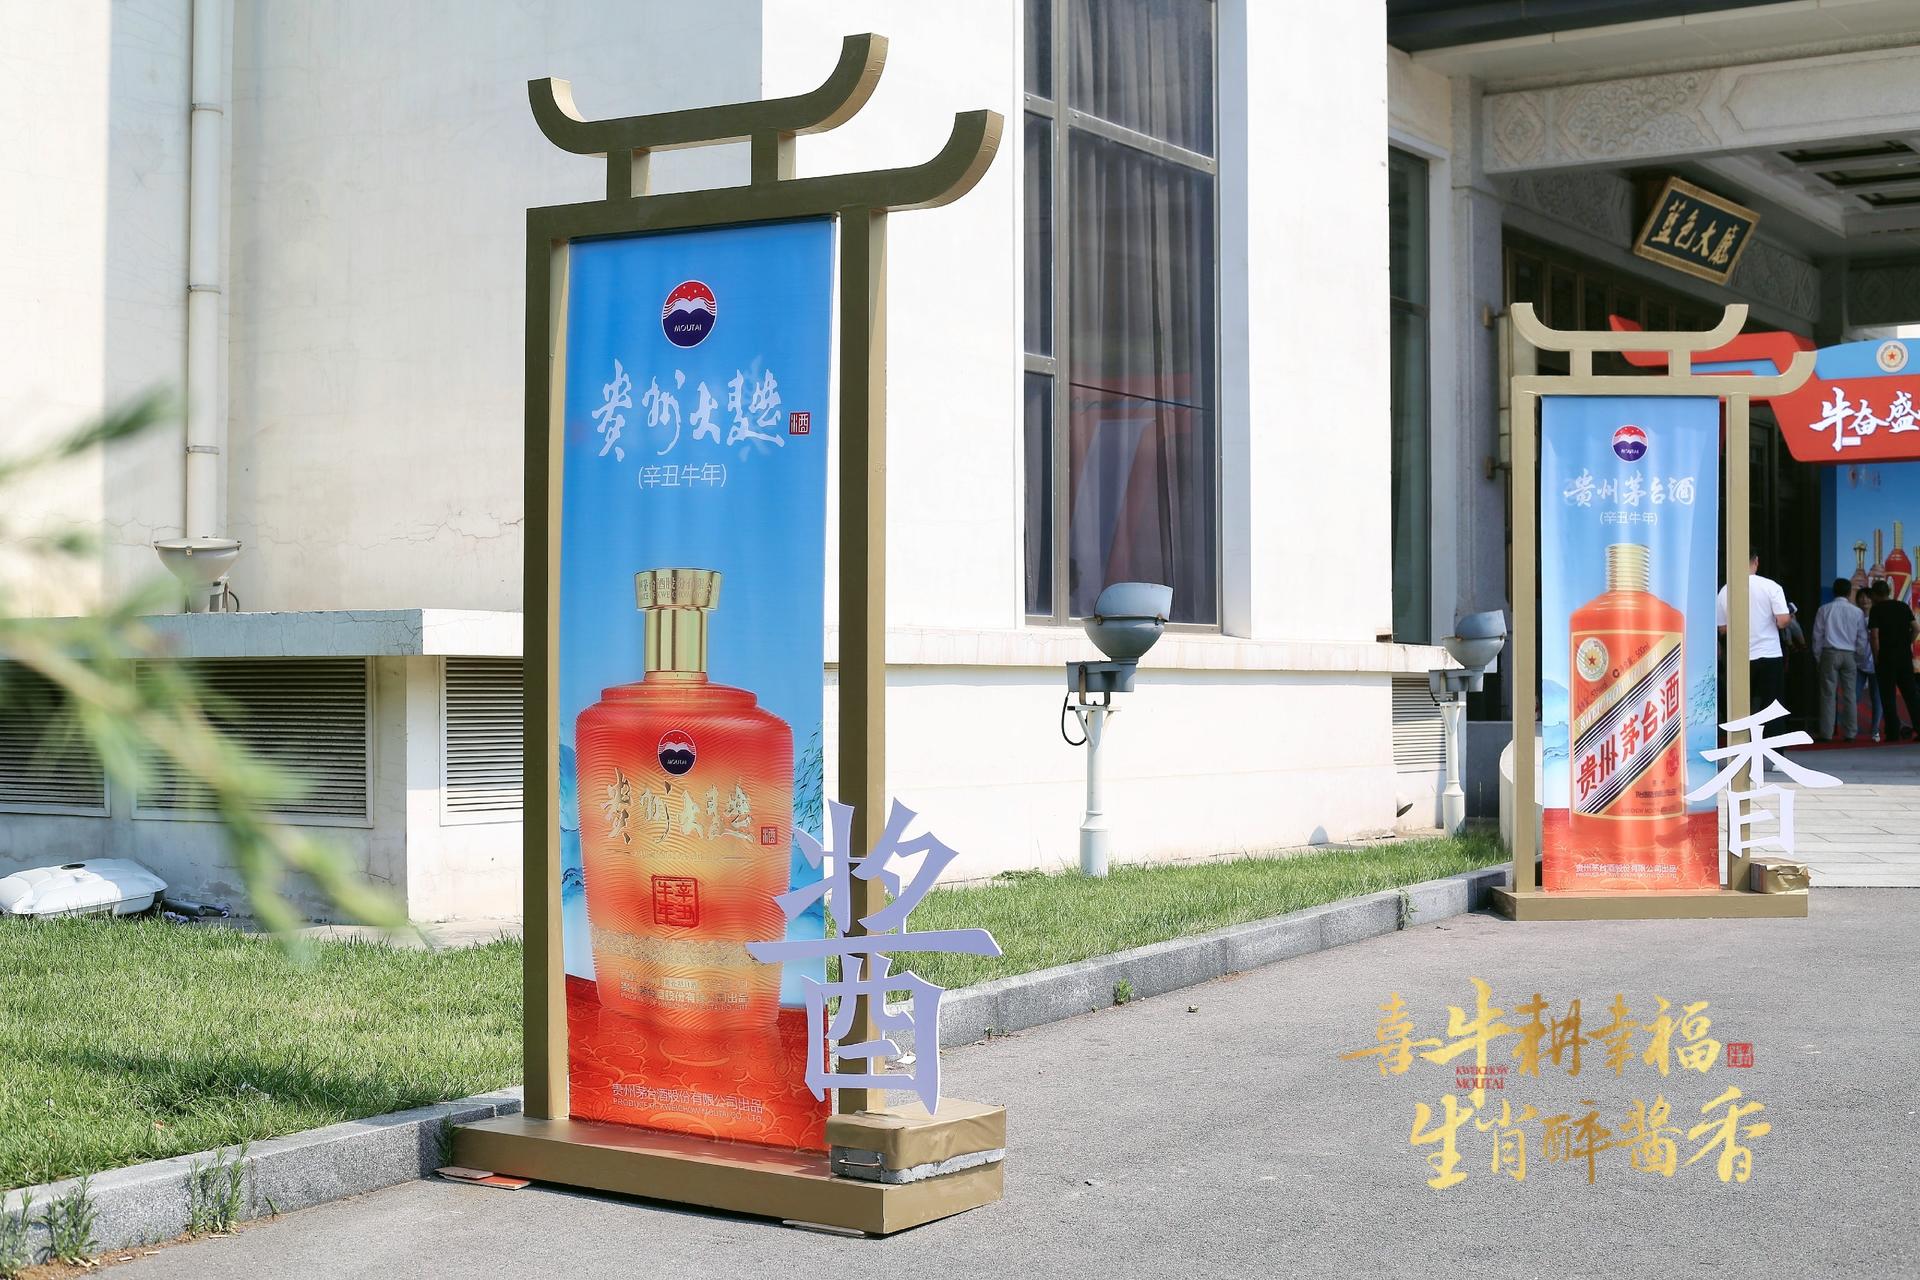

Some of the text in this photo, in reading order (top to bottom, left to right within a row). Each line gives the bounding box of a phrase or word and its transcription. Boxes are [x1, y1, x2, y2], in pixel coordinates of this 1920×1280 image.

[673, 323, 702, 333] MOUTAI
[789, 411, 811, 435] 酒
[637, 462, 727, 490] (辛丑牛年)
[1562, 467, 1697, 508] 贵州茅台酒
[1576, 670, 1680, 802] 贵州茅台酒
[1682, 699, 1844, 858] 香
[611, 1082, 764, 1115] 贵州茅台酒股份有限公司出品
